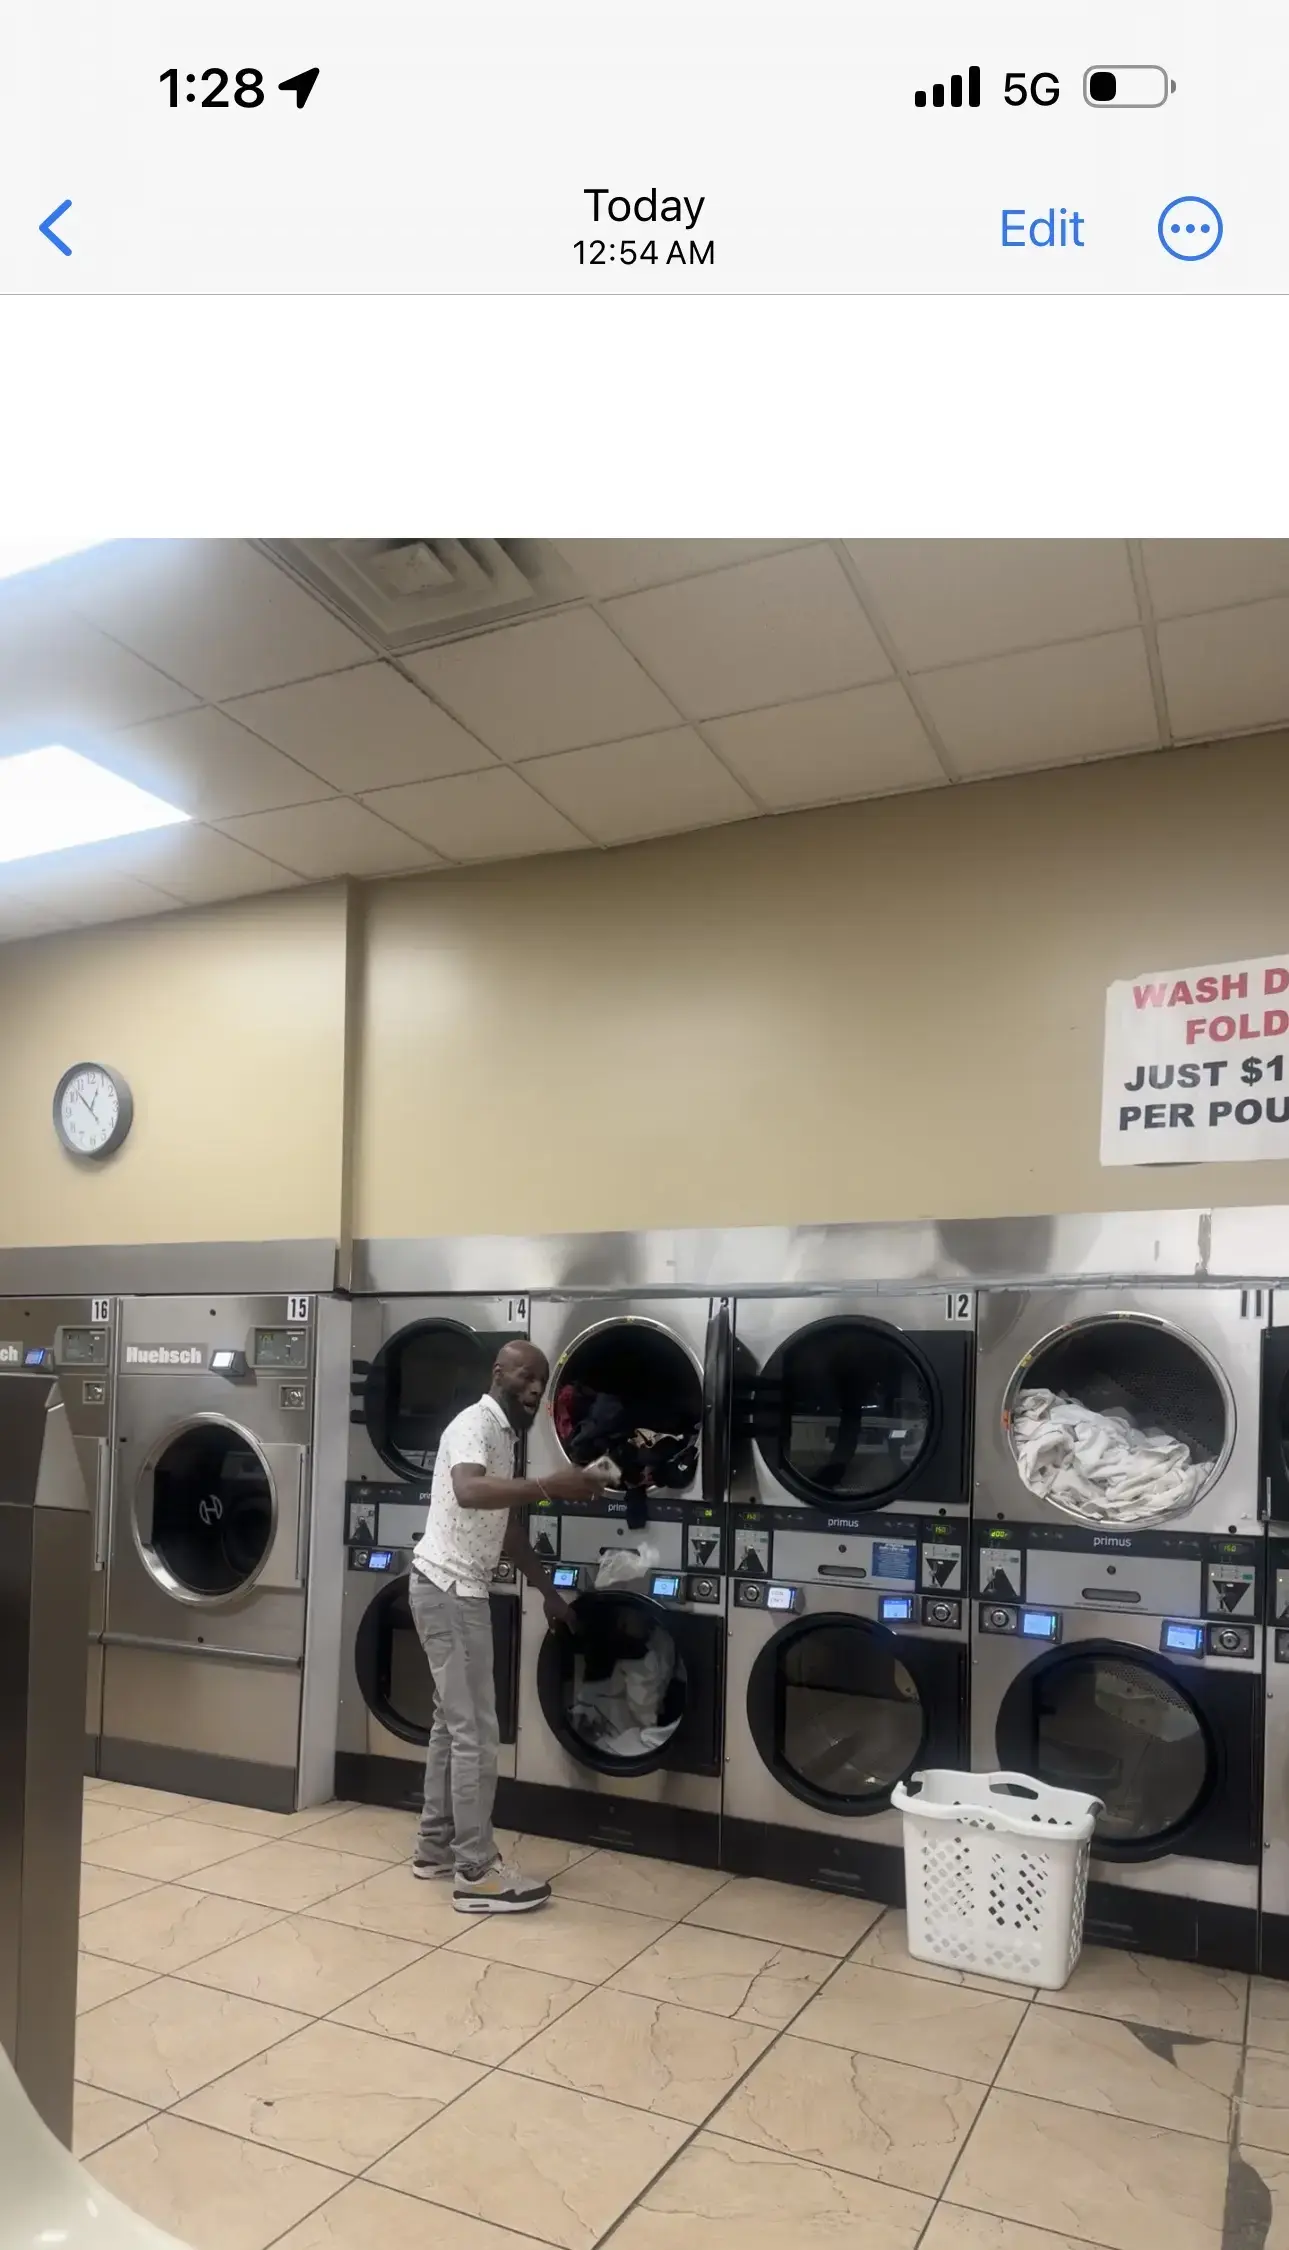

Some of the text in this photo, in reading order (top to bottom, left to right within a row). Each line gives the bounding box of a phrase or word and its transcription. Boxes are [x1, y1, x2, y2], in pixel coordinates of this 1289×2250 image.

[1133, 972, 1248, 1010] WASH
[1186, 1010, 1289, 1045] FOLD
[1124, 1055, 1284, 1092] JUST $1
[1119, 1096, 1289, 1131] PER POU
[95, 1301, 108, 1319] 16
[291, 1298, 306, 1318] 15
[508, 1299, 526, 1321] 14
[948, 1294, 969, 1318] 12
[1241, 1290, 1262, 1317] 11
[126, 1346, 202, 1364] Huebsch
[607, 1502, 628, 1513] prim
[828, 1518, 859, 1528] primus
[1093, 1535, 1132, 1547] primus
